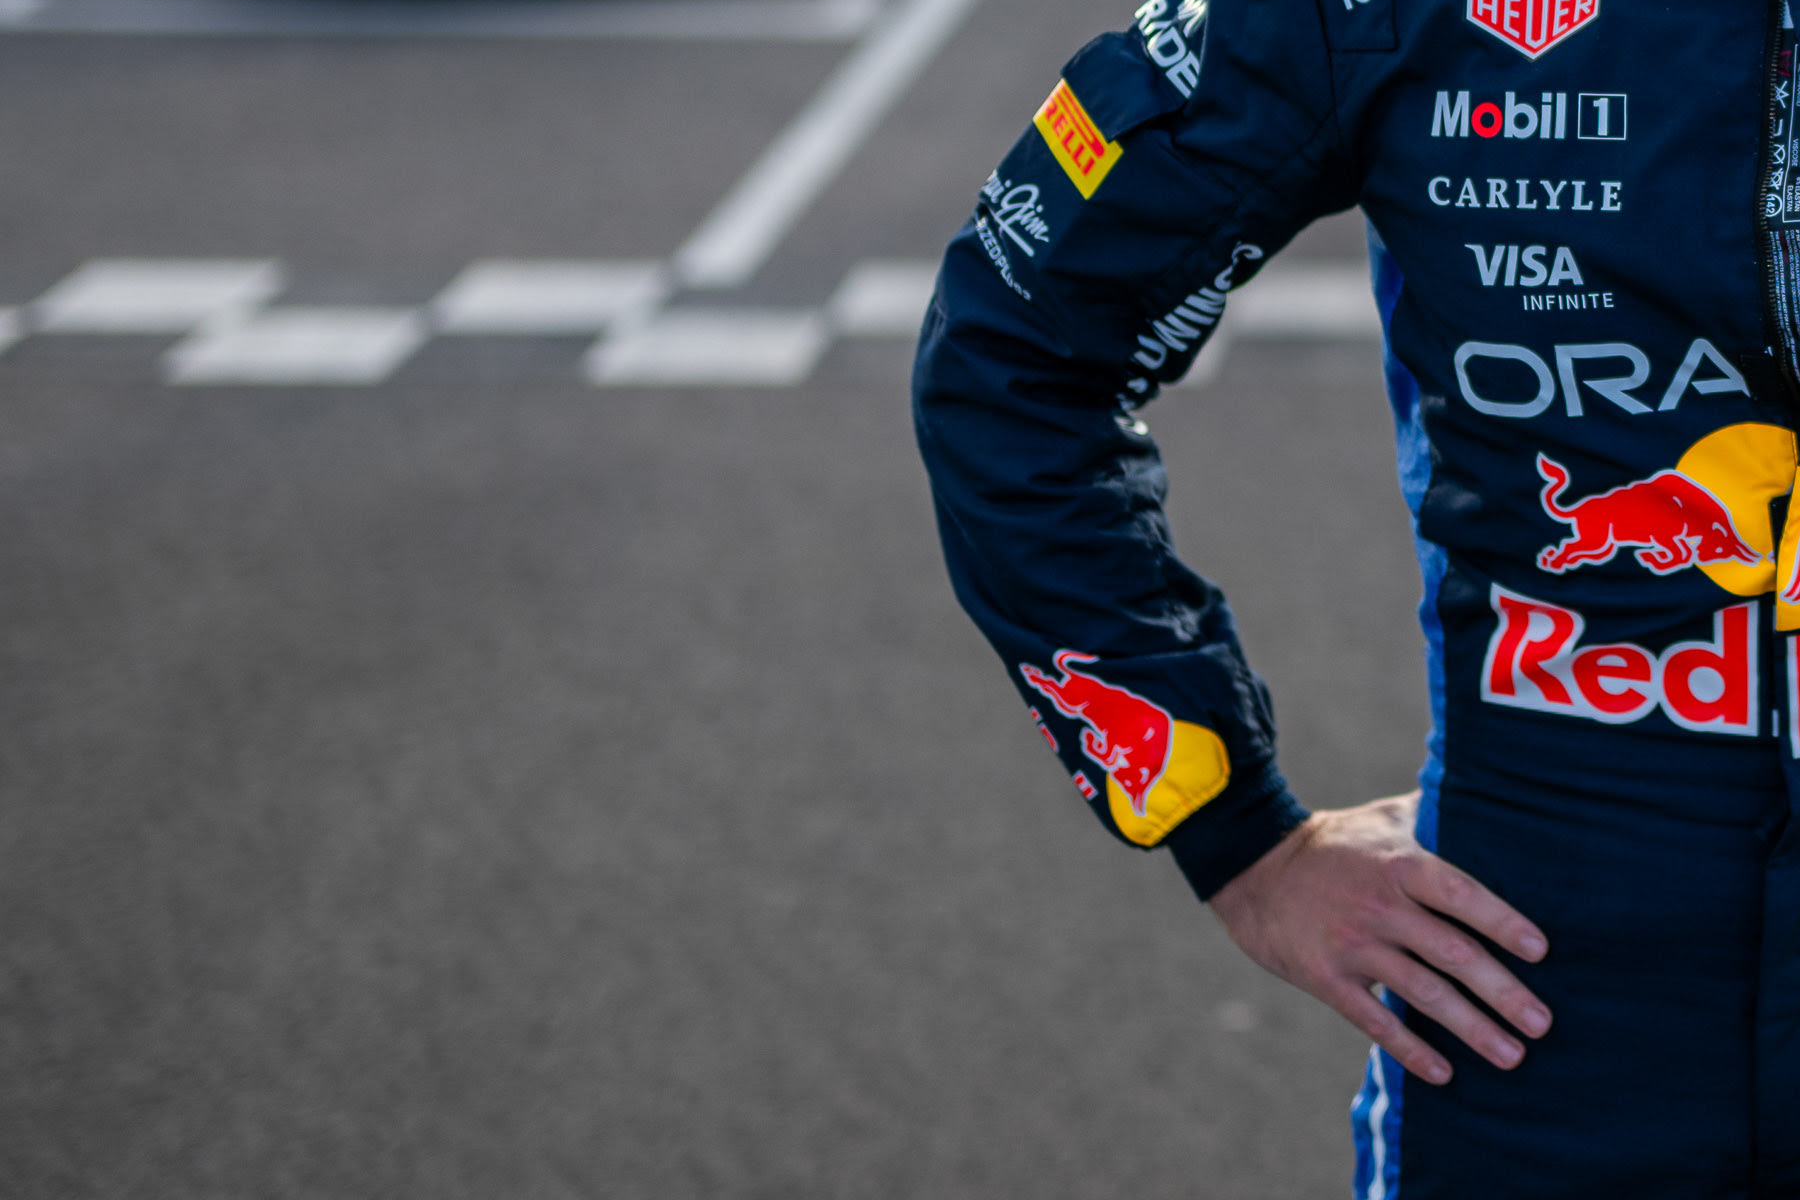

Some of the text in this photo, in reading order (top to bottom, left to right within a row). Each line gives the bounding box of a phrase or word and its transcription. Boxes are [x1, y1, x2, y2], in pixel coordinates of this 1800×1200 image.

[1431, 91, 1609, 139] Mobil 1
[1427, 176, 1622, 211] CARLYLE
[1464, 244, 1584, 287] VISA
[1523, 292, 1615, 311] INFINITE
[1483, 587, 1756, 733] Red
